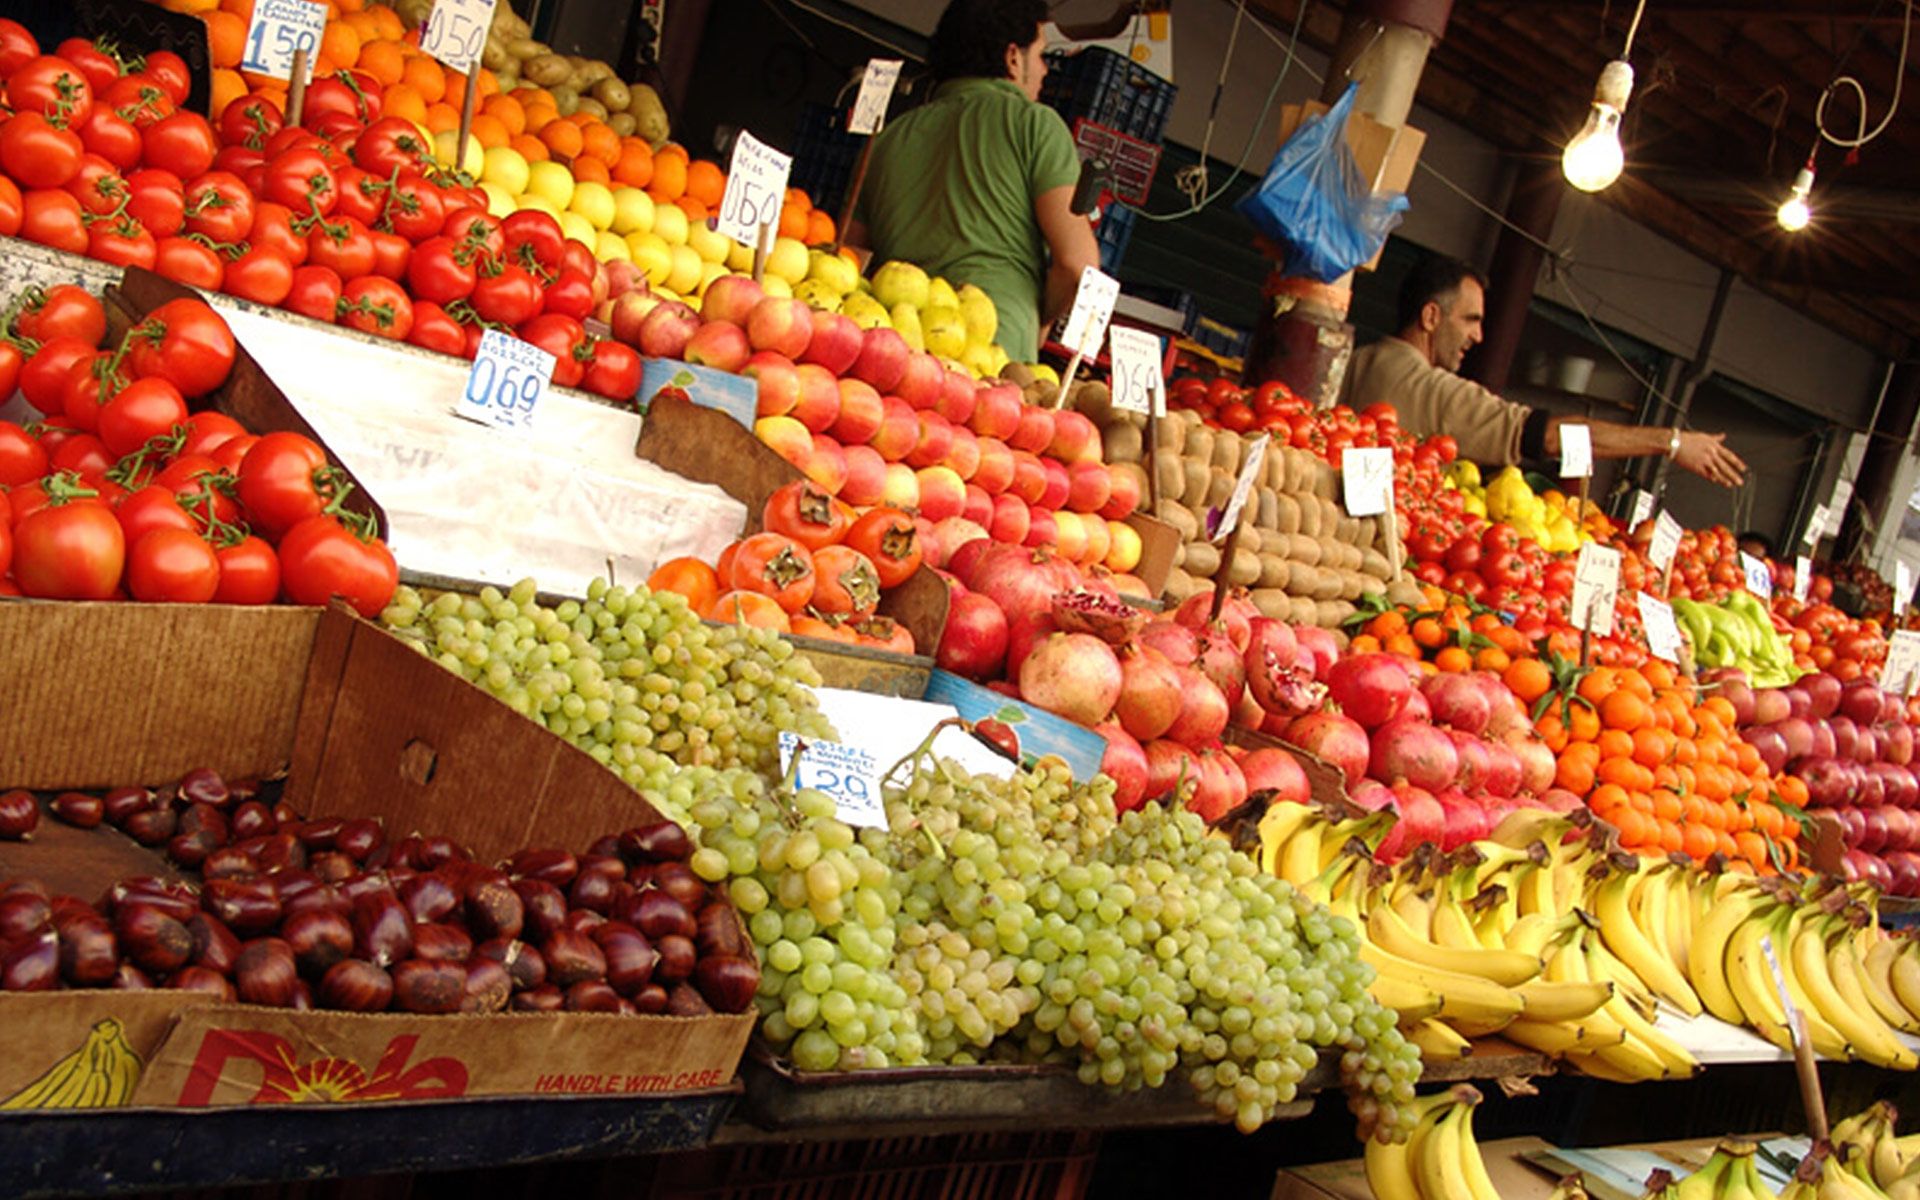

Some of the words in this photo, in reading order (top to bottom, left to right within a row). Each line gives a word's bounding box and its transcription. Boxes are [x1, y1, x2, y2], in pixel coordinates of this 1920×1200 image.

[466, 357, 541, 413] 0.69
[534, 1072, 621, 1092] HANDLE
[624, 1074, 673, 1093] WITH
[674, 1069, 723, 1089] CARE
